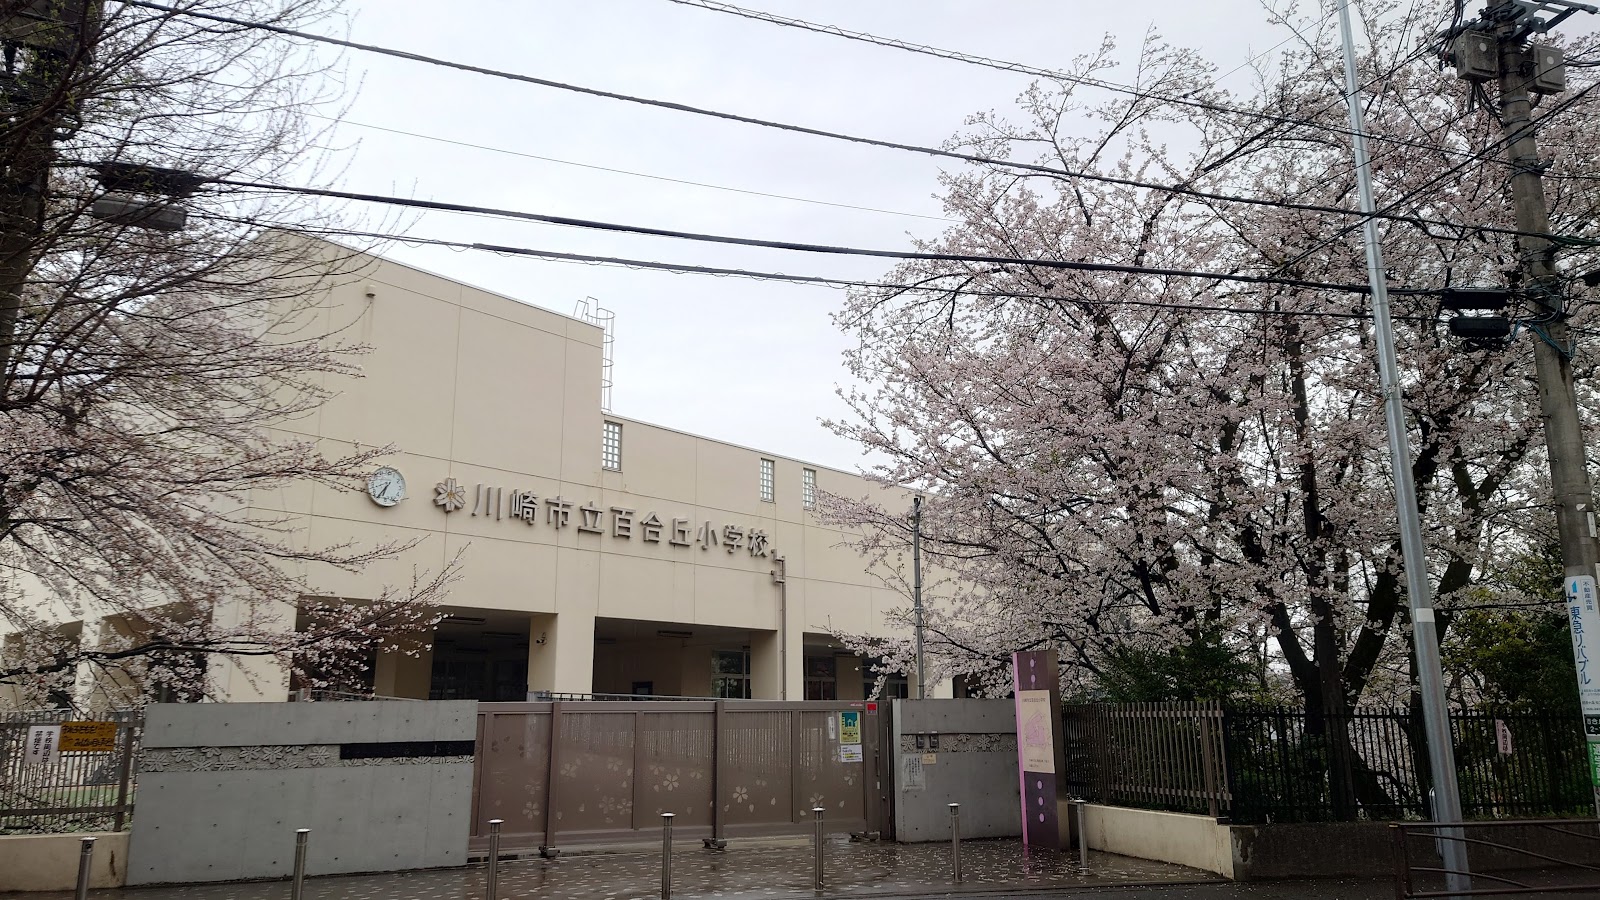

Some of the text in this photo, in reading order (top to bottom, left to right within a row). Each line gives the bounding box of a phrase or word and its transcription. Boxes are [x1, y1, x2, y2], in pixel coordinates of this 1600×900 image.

[471, 483, 769, 558] 川崎市立百合丘小学校
[1582, 581, 1593, 611] 不動産売買
[1570, 606, 1591, 685] 東急リバブル
